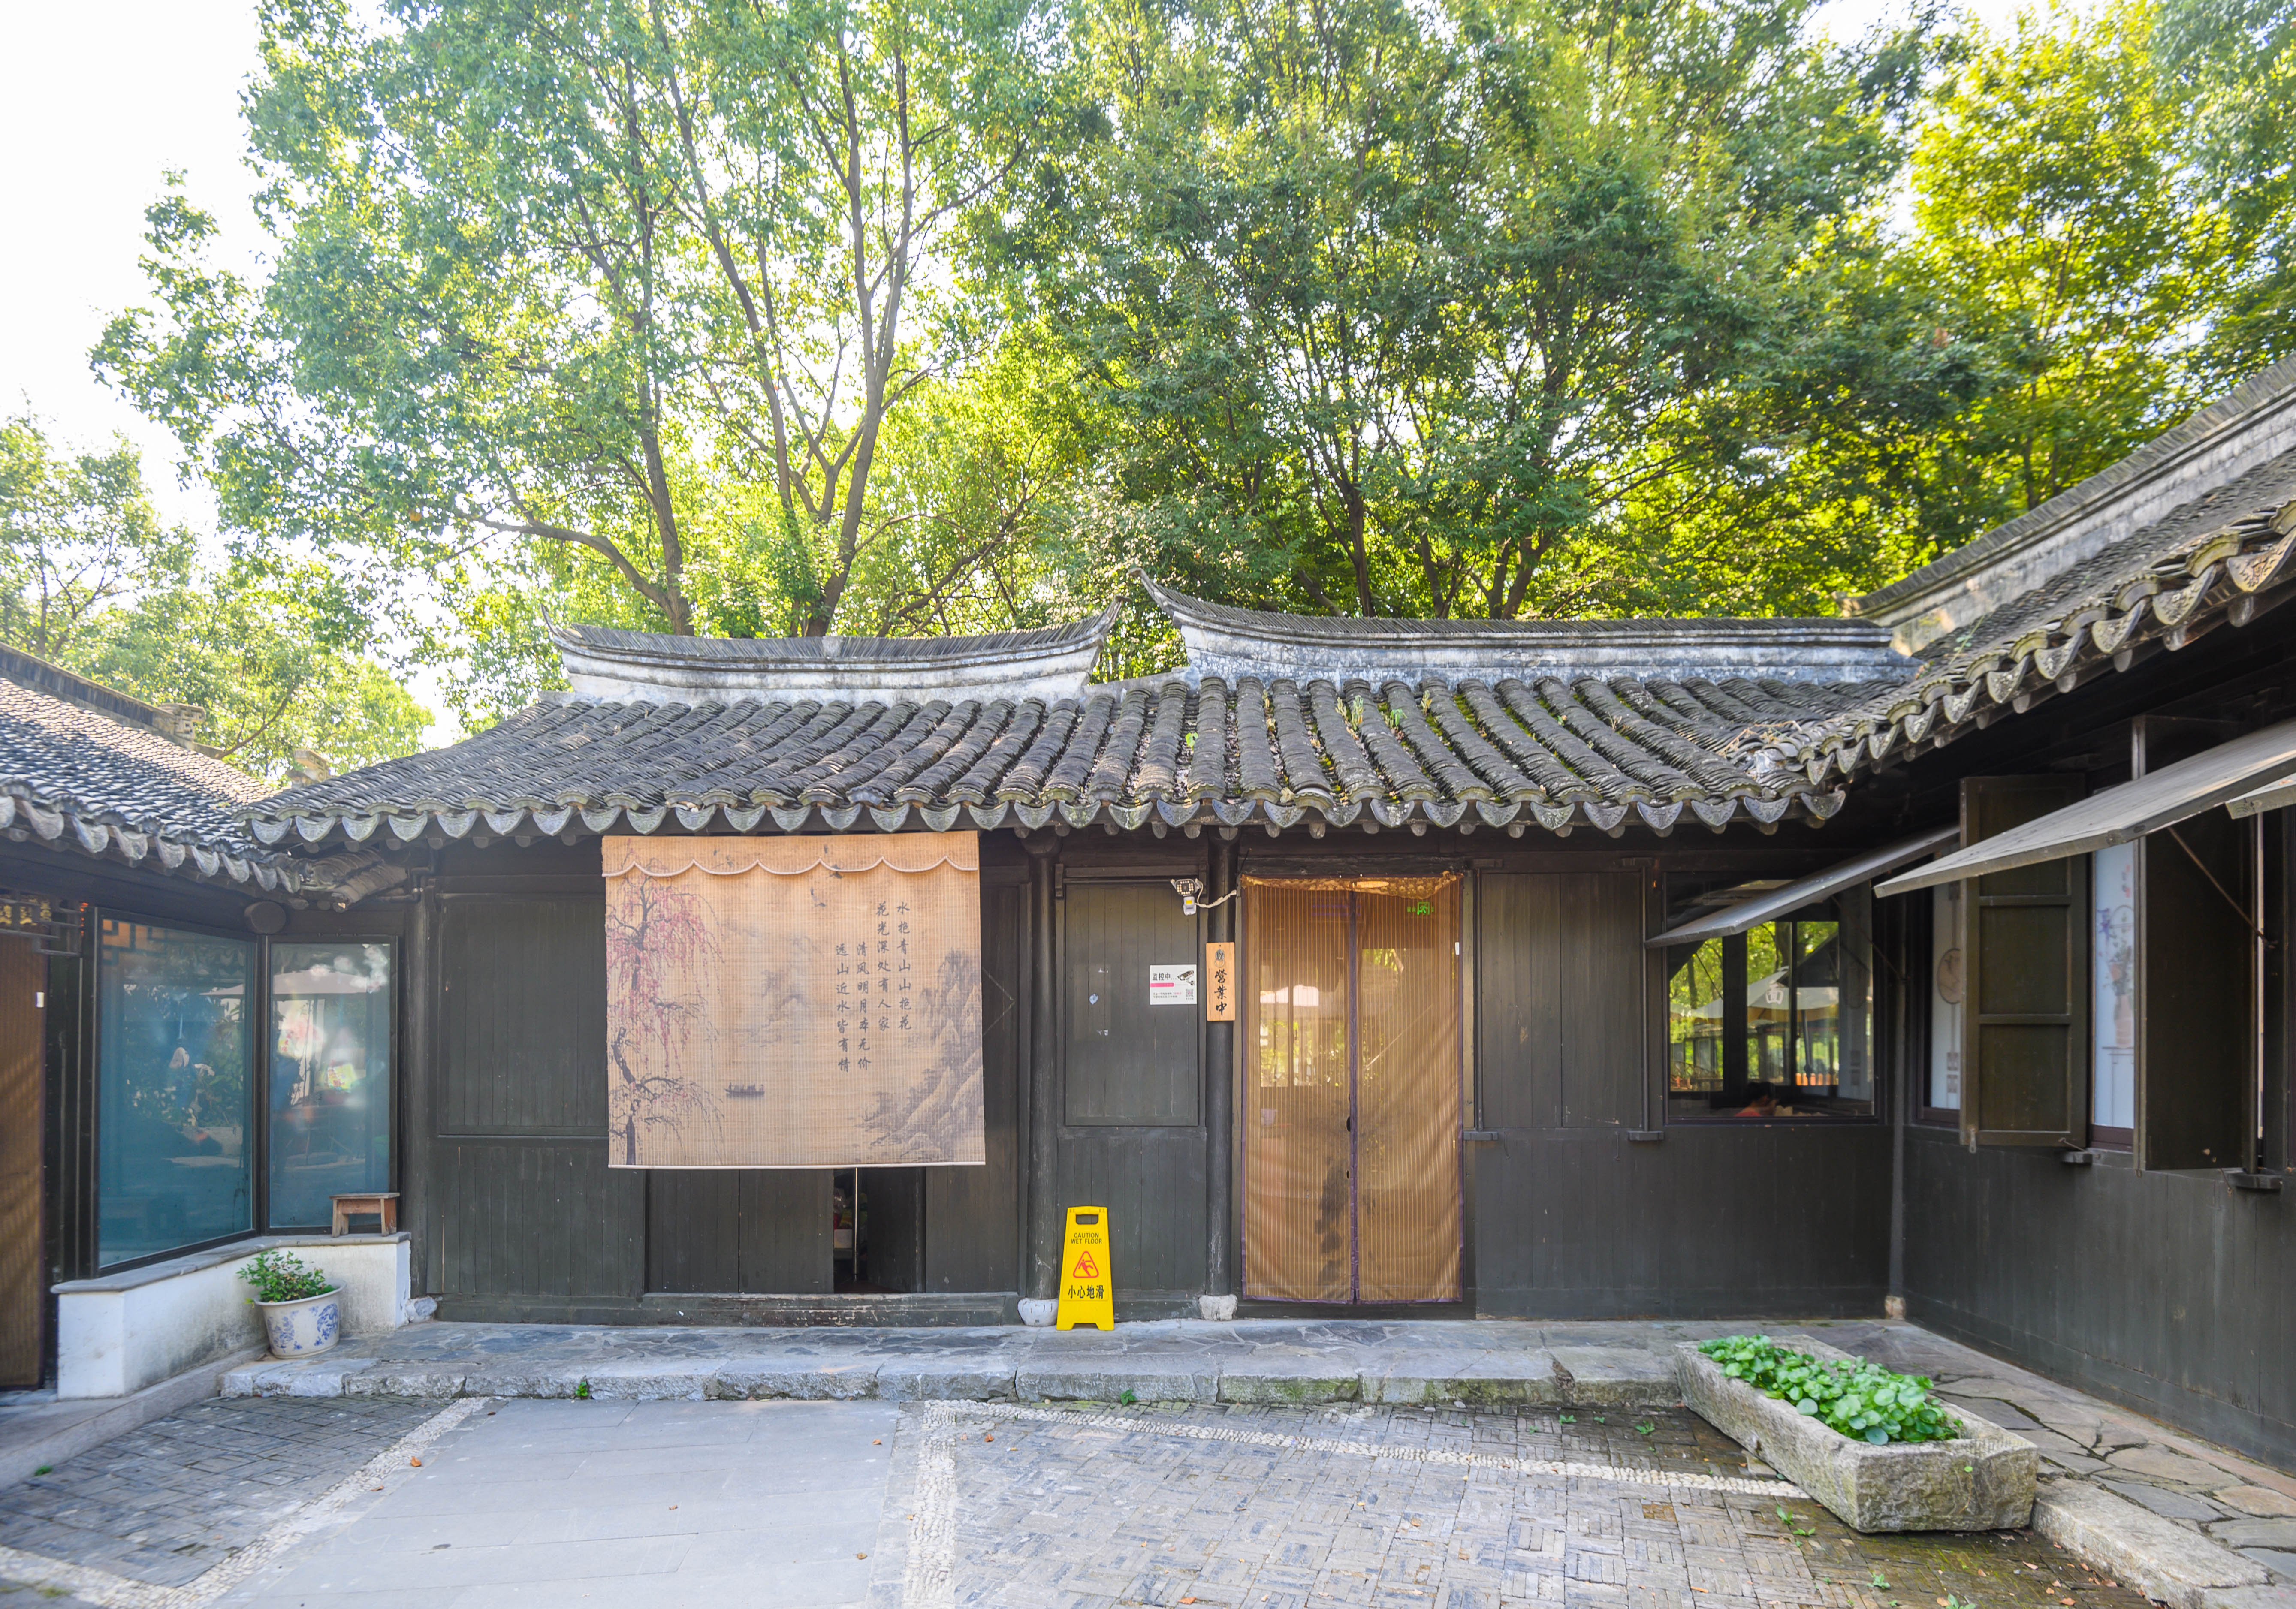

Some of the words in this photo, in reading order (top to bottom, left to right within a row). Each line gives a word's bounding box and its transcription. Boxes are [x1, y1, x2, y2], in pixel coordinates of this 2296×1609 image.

[835, 943, 851, 1073] 远山近水皆有情
[857, 941, 872, 1071] 清风明月本无价
[876, 901, 891, 1031] 花光深处有人家
[1068, 1285, 1104, 1299] 小心地滑
